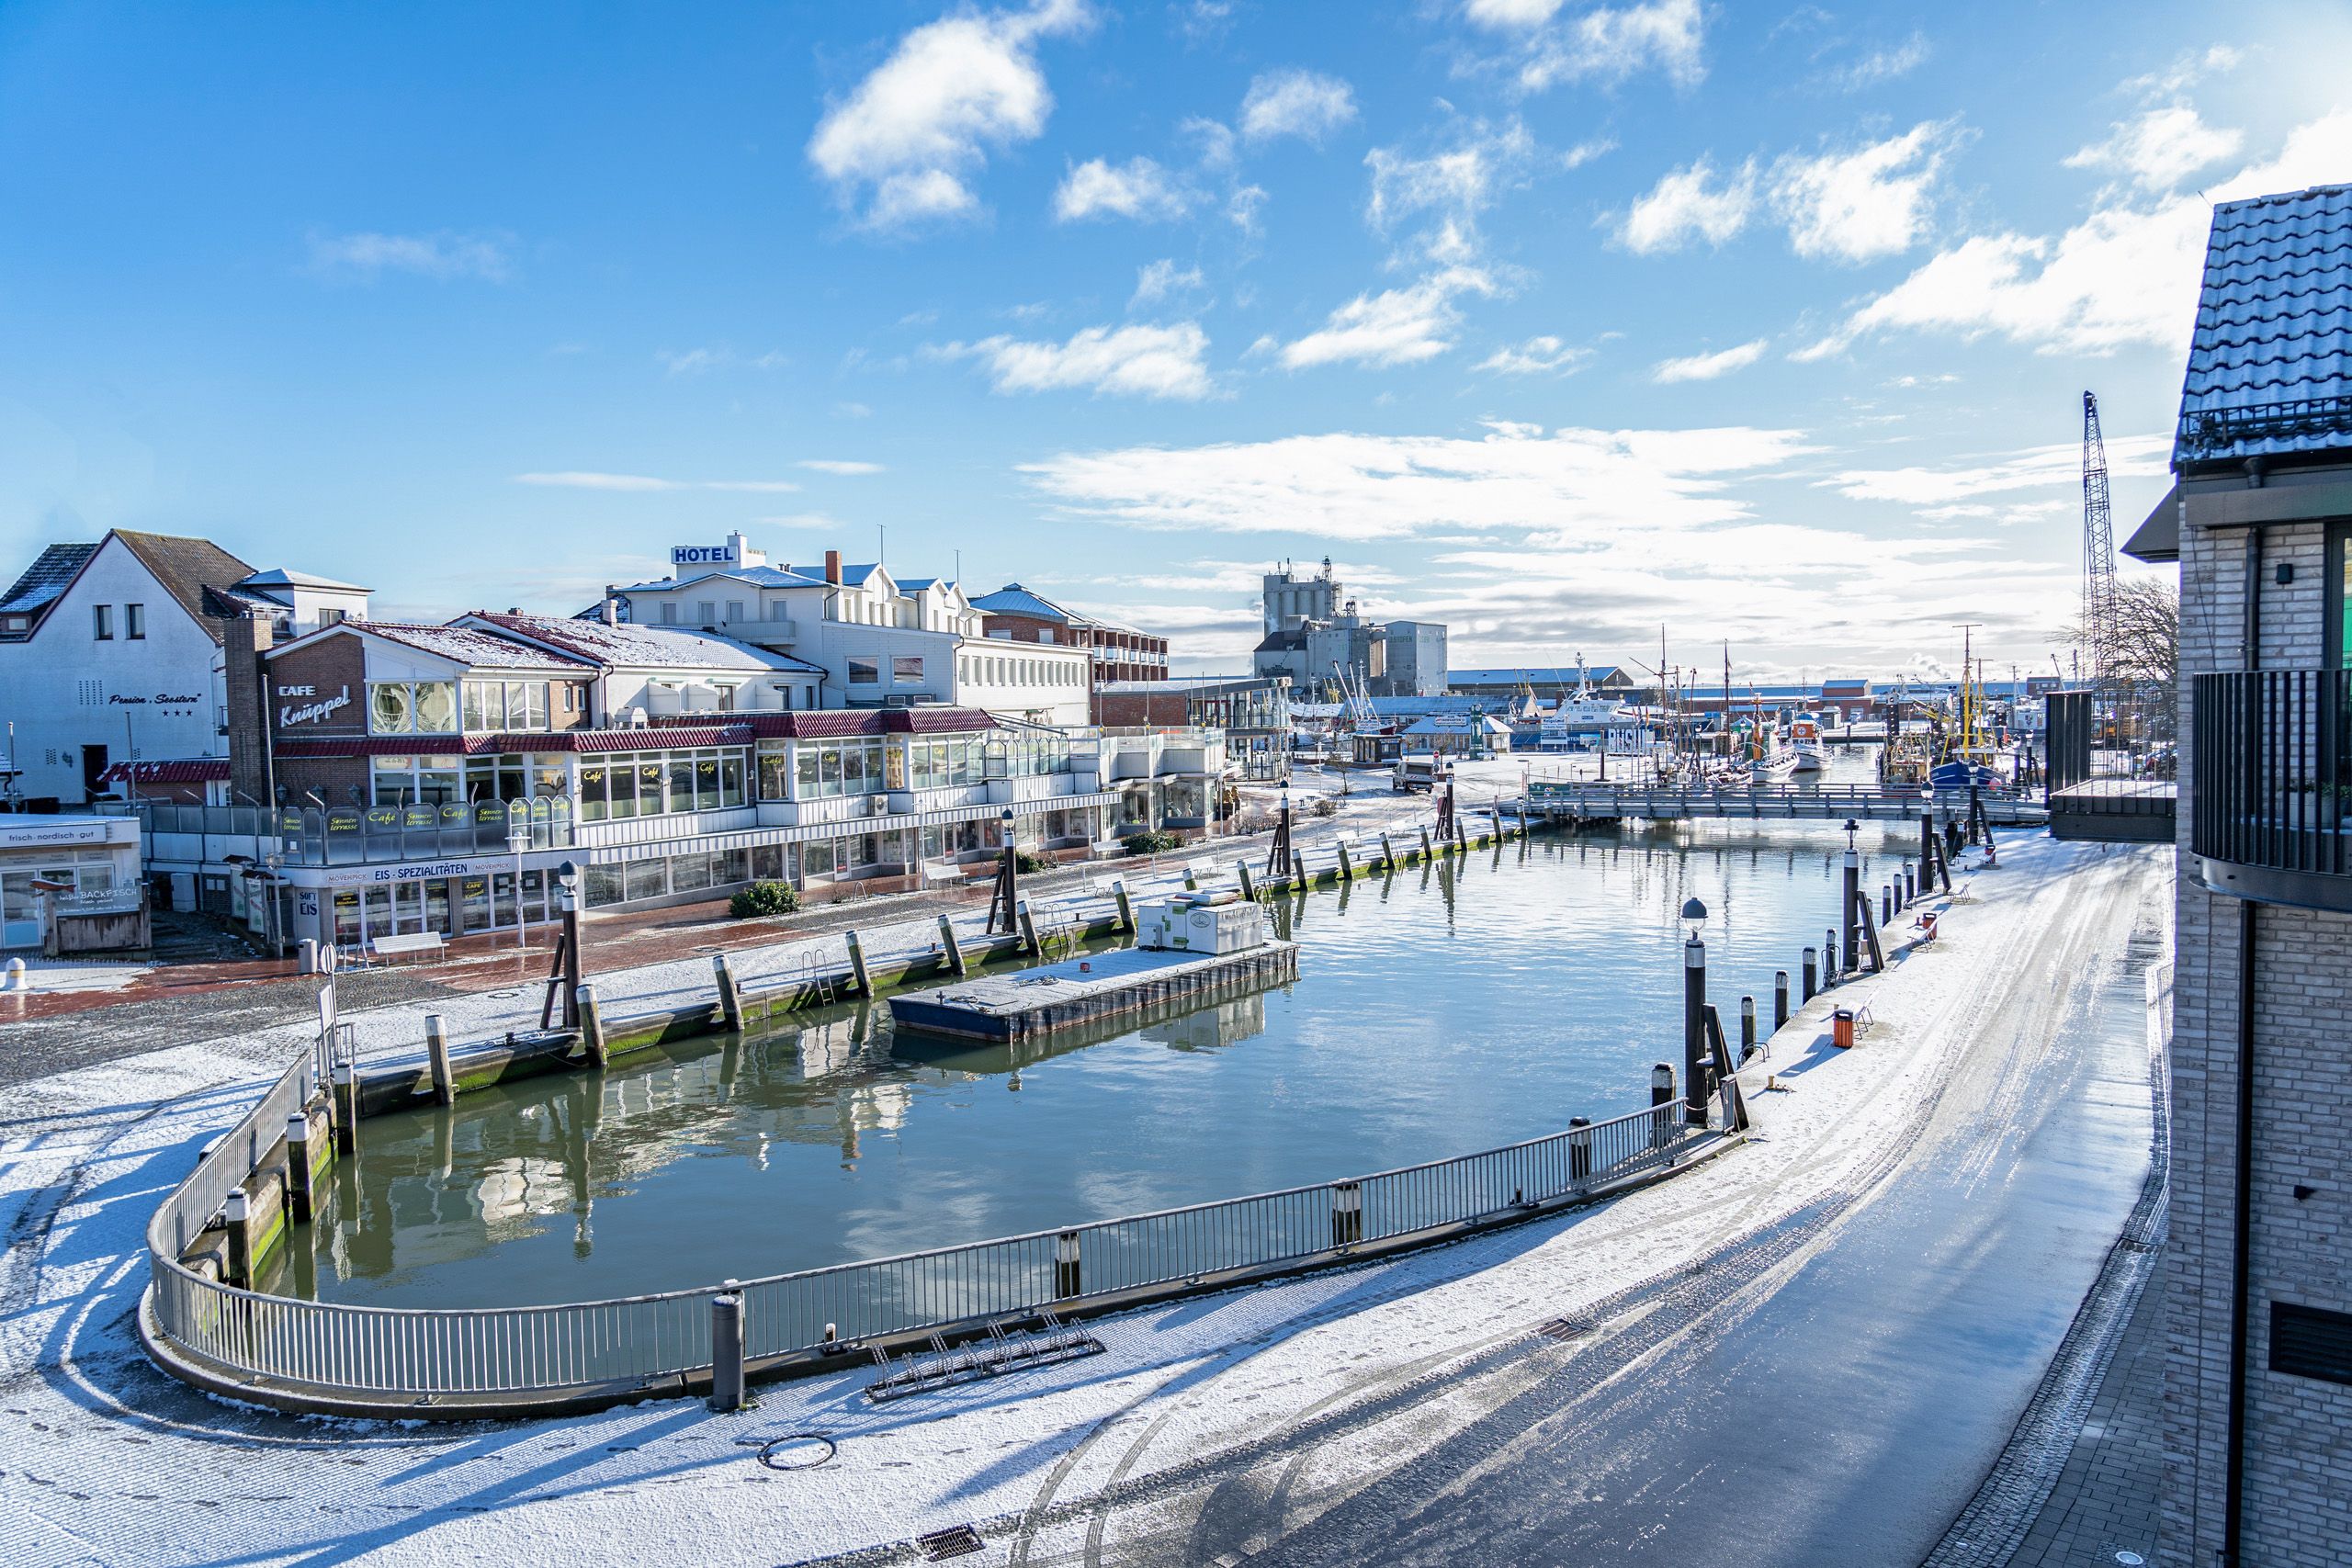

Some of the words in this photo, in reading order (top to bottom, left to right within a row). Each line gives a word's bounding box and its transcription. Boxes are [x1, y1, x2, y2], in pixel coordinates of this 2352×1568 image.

[674, 547, 733, 562] HOTEL
[278, 685, 316, 696] CAFE
[108, 694, 146, 705] Pension
[280, 684, 351, 728] Knüppel
[643, 767, 659, 778] Café
[699, 763, 714, 773] Café
[584, 771, 602, 783] Café
[368, 812, 396, 825] Café
[442, 807, 468, 820] Café
[38, 831, 74, 840] nordisch
[375, 870, 390, 880] EIS
[398, 863, 468, 878] SPEZIALITÄTEN
[300, 892, 317, 900] SOFT
[300, 902, 318, 916] EIS
